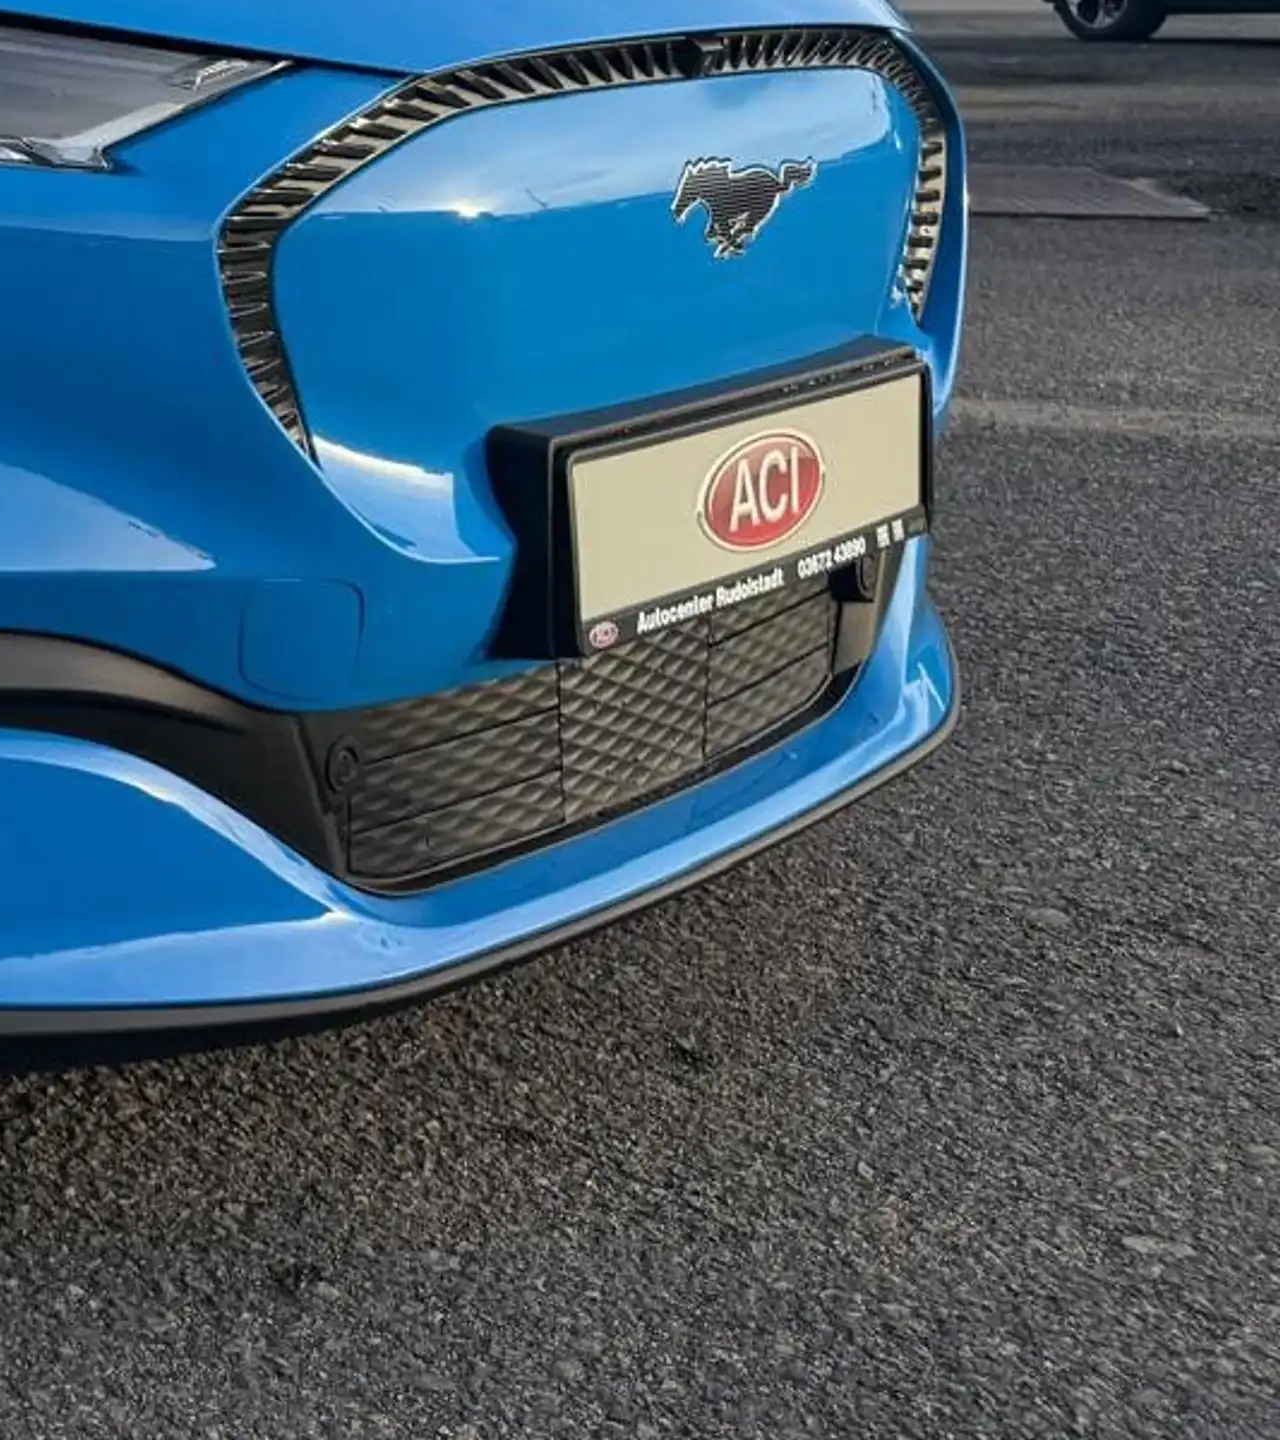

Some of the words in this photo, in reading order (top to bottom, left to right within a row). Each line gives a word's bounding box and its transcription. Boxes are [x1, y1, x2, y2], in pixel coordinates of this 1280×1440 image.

[729, 446, 801, 532] ACI
[637, 594, 714, 633] Autocenter
[716, 567, 785, 607] Rudolstadt
